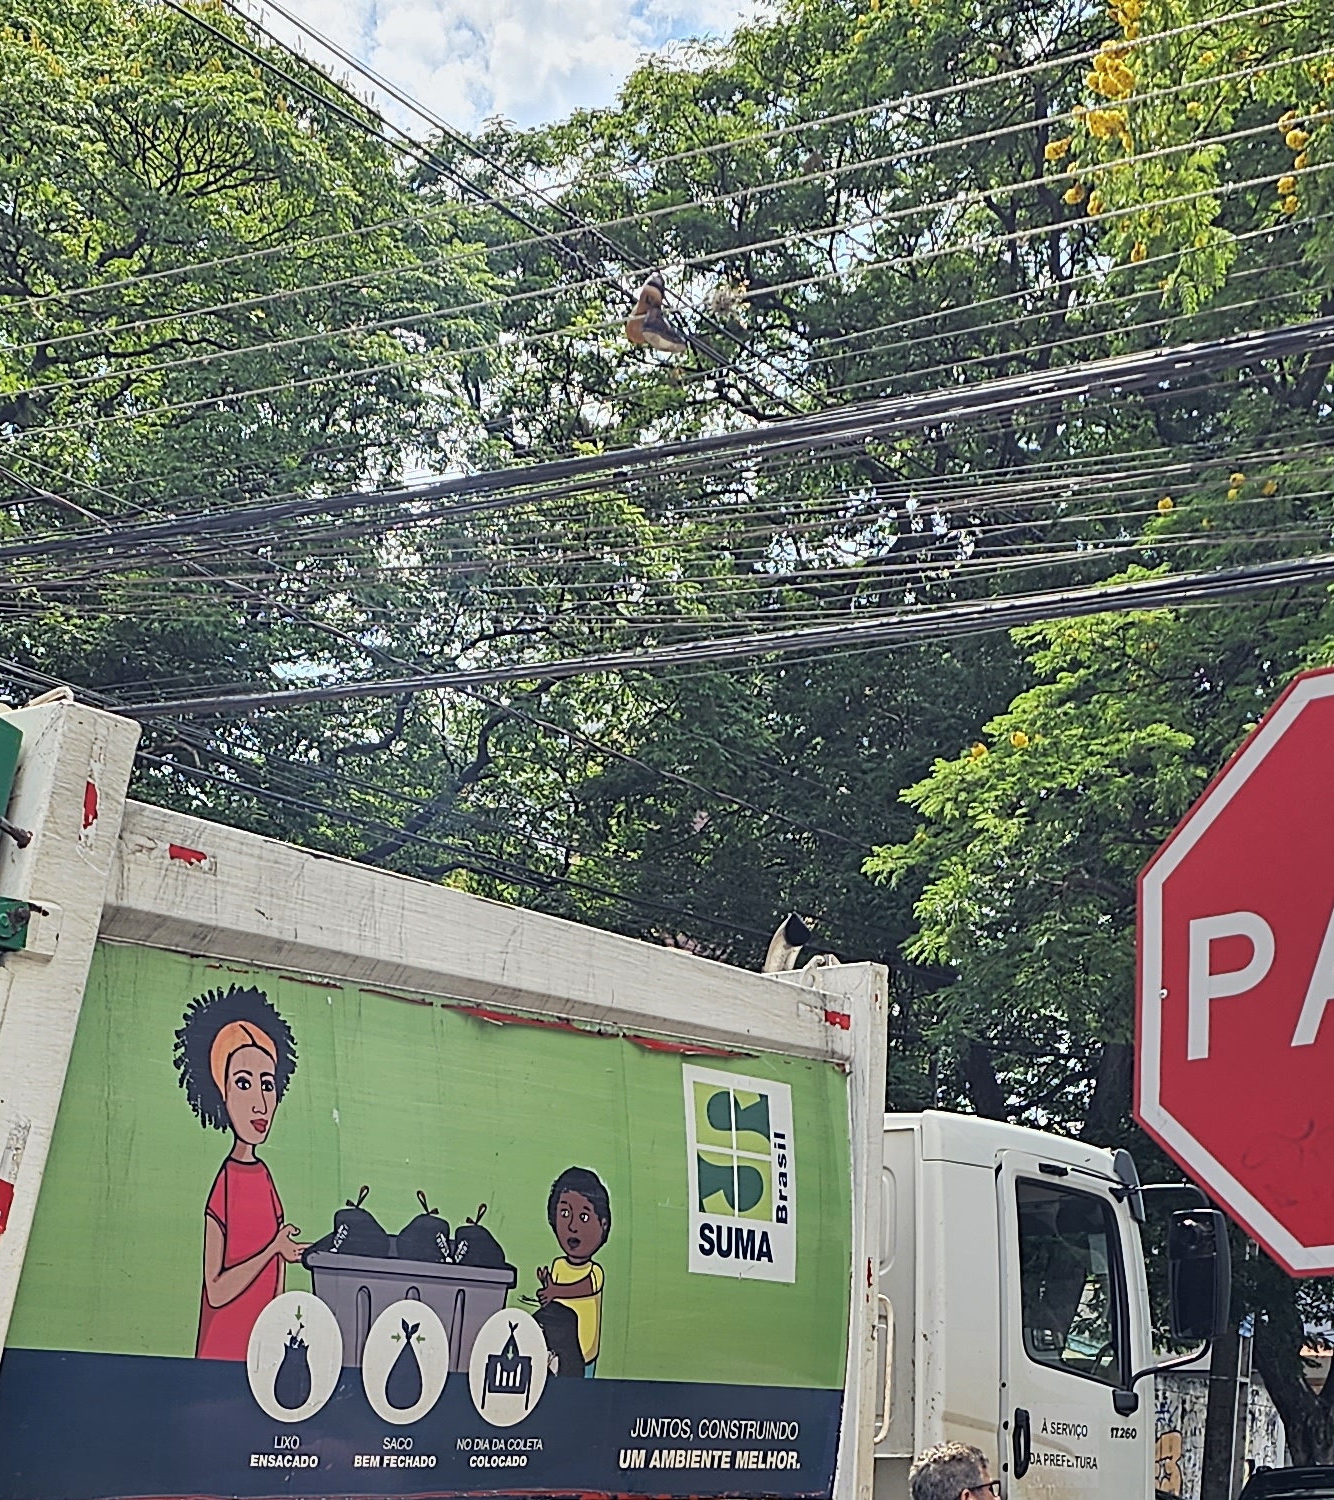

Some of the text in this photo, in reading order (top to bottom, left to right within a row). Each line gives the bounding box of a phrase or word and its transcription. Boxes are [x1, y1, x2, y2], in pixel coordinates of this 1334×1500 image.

[773, 1131, 789, 1225] Brasil
[698, 1222, 774, 1264] SUMA
[630, 1418, 799, 1442] JUNTOS, CONSTRUINDO
[1050, 1421, 1088, 1441] SERVIÇO
[273, 1435, 300, 1450] LIXO
[382, 1437, 413, 1450] SACO
[456, 1438, 544, 1451] NO DIA DA COLETA
[250, 1454, 318, 1469] ENSACADO
[354, 1455, 437, 1469] BEM FECHADO
[469, 1455, 528, 1468] COLOCADO
[619, 1449, 802, 1470] UM AMBIENTE MELHOR.
[1044, 1452, 1098, 1470] PREFETURA
